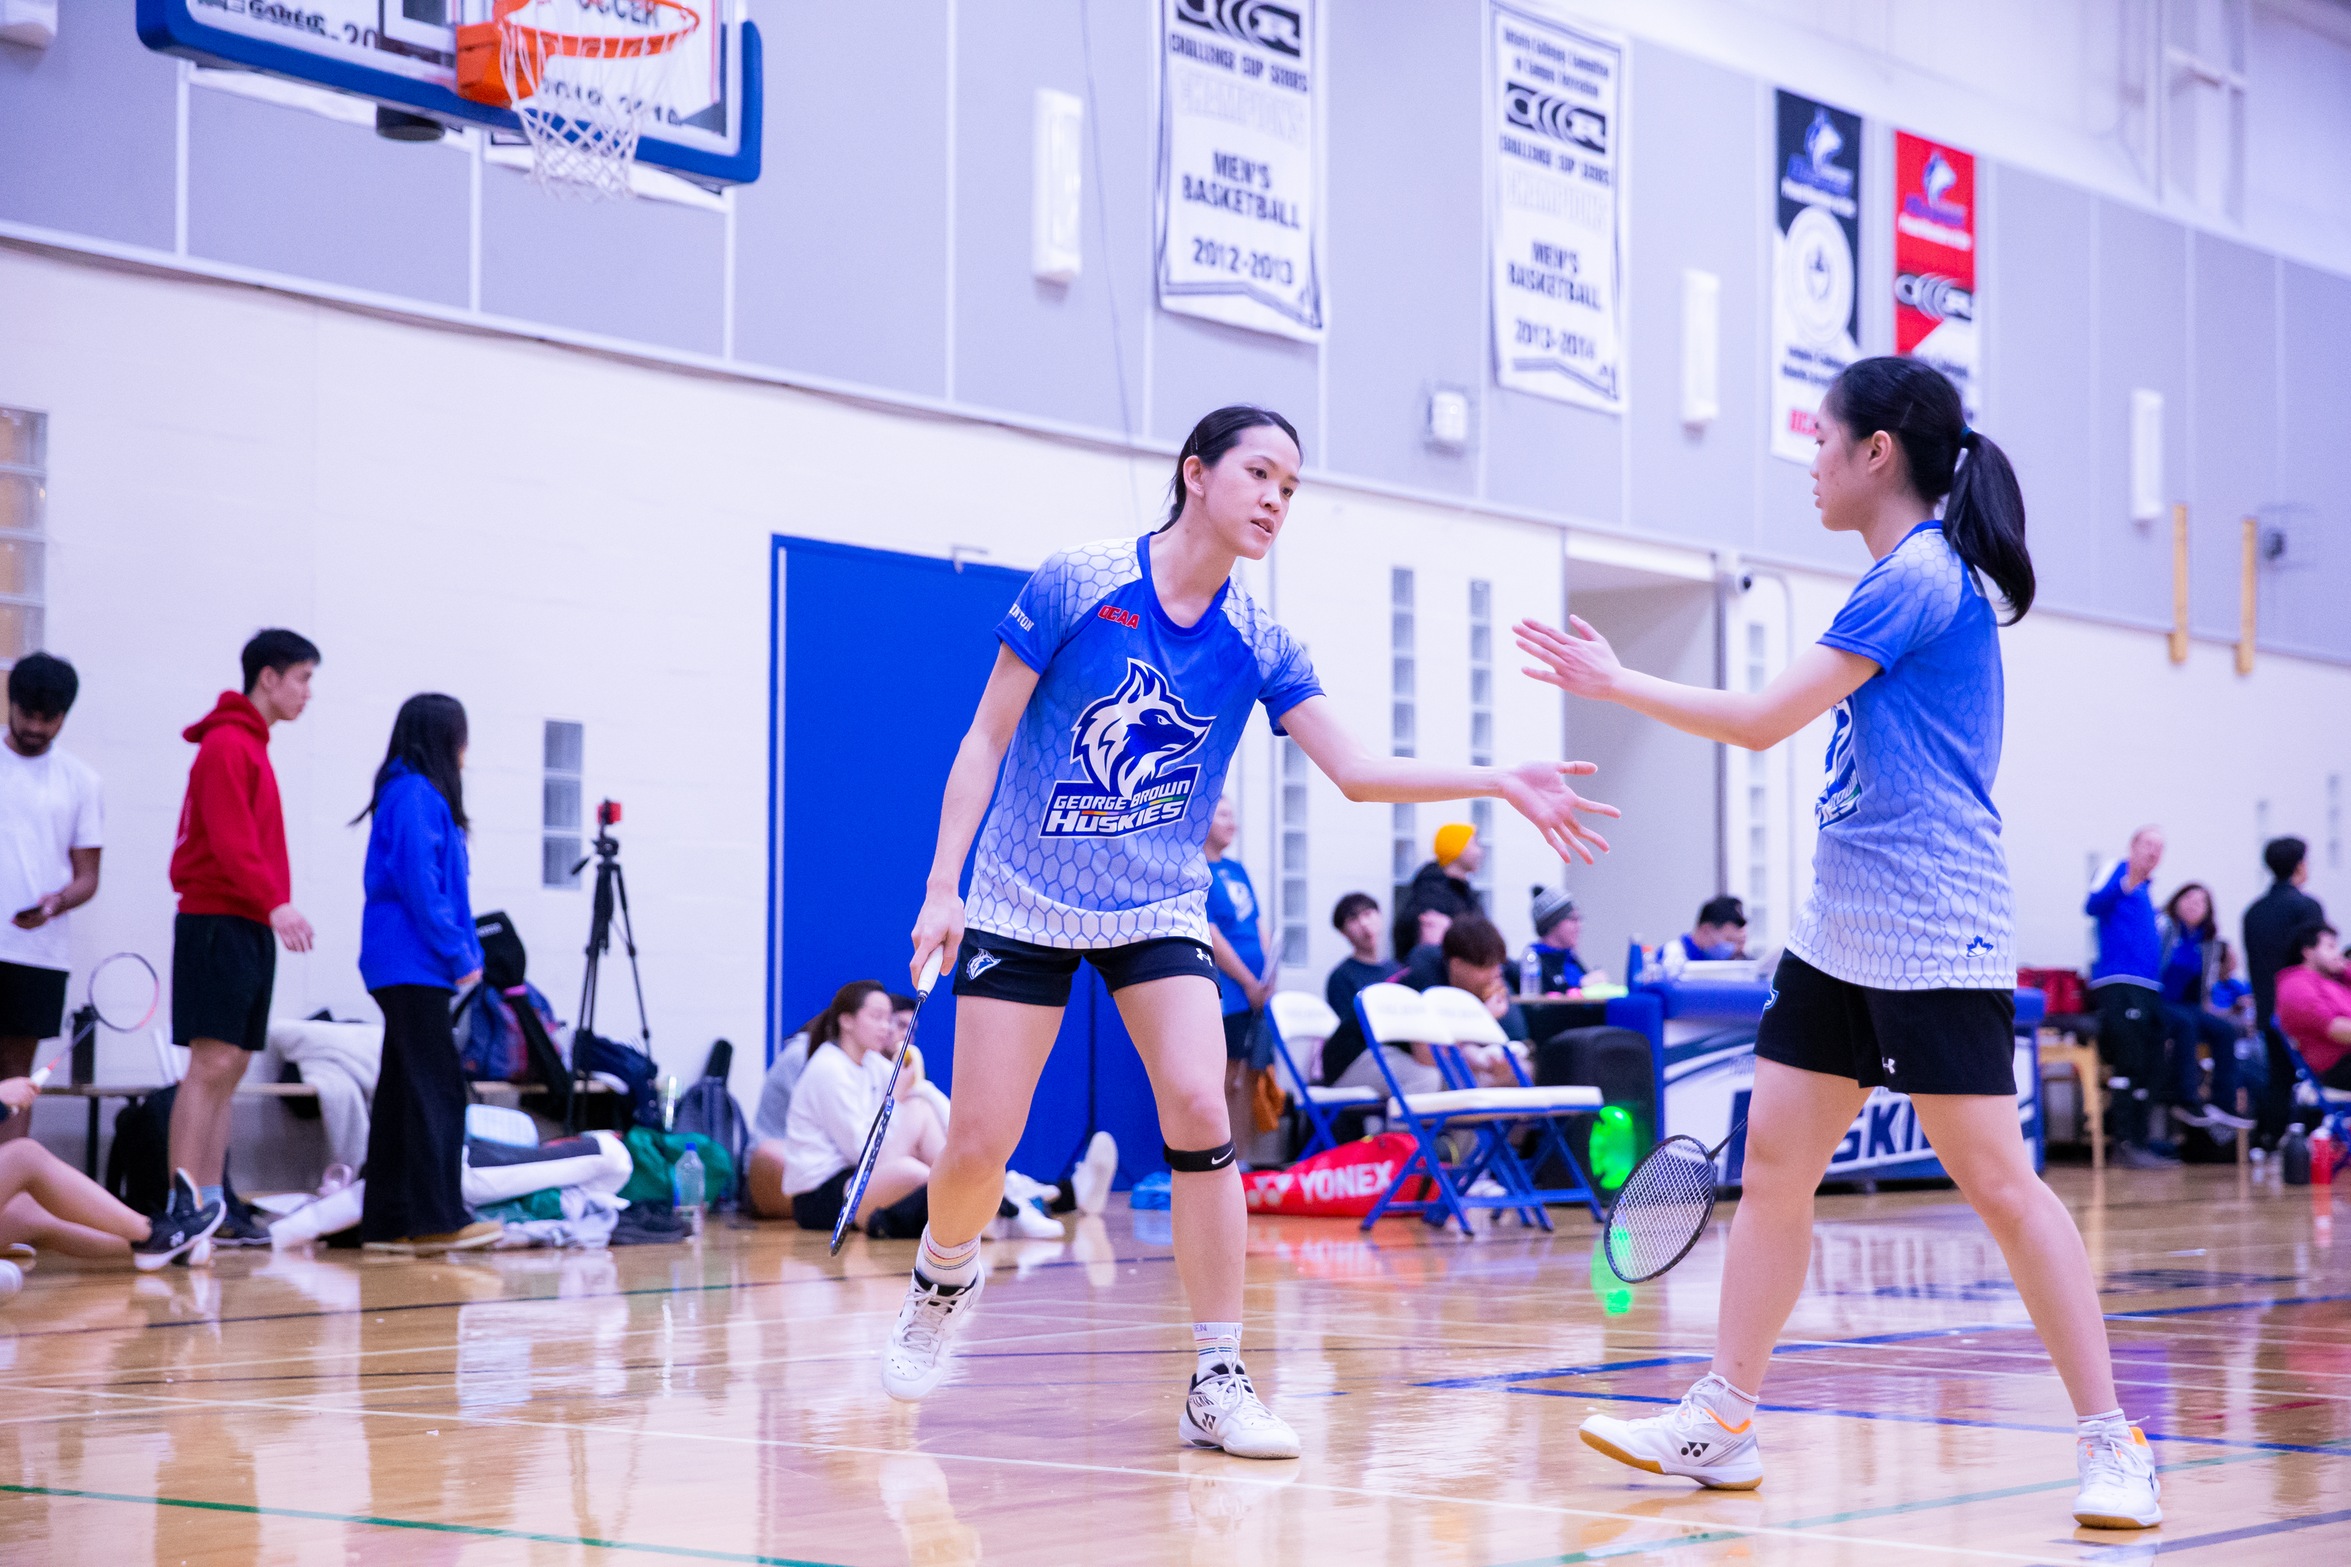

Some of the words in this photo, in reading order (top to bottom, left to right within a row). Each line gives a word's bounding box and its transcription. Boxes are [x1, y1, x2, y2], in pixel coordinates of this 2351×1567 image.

[1213, 150, 1271, 190] MEN'S
[1183, 174, 1300, 230] BASKETBALL
[1193, 237, 1294, 285] 2012-2013
[1533, 240, 1578, 274] MEN'S
[1509, 262, 1602, 312] BASKETBALL
[1098, 605, 1140, 630] OCAA
[1053, 795, 1127, 810] GEORGE
[1130, 780, 1191, 809] BROWN
[1045, 800, 1185, 833] HUSKIES
[1299, 1160, 1392, 1203] YONEX
